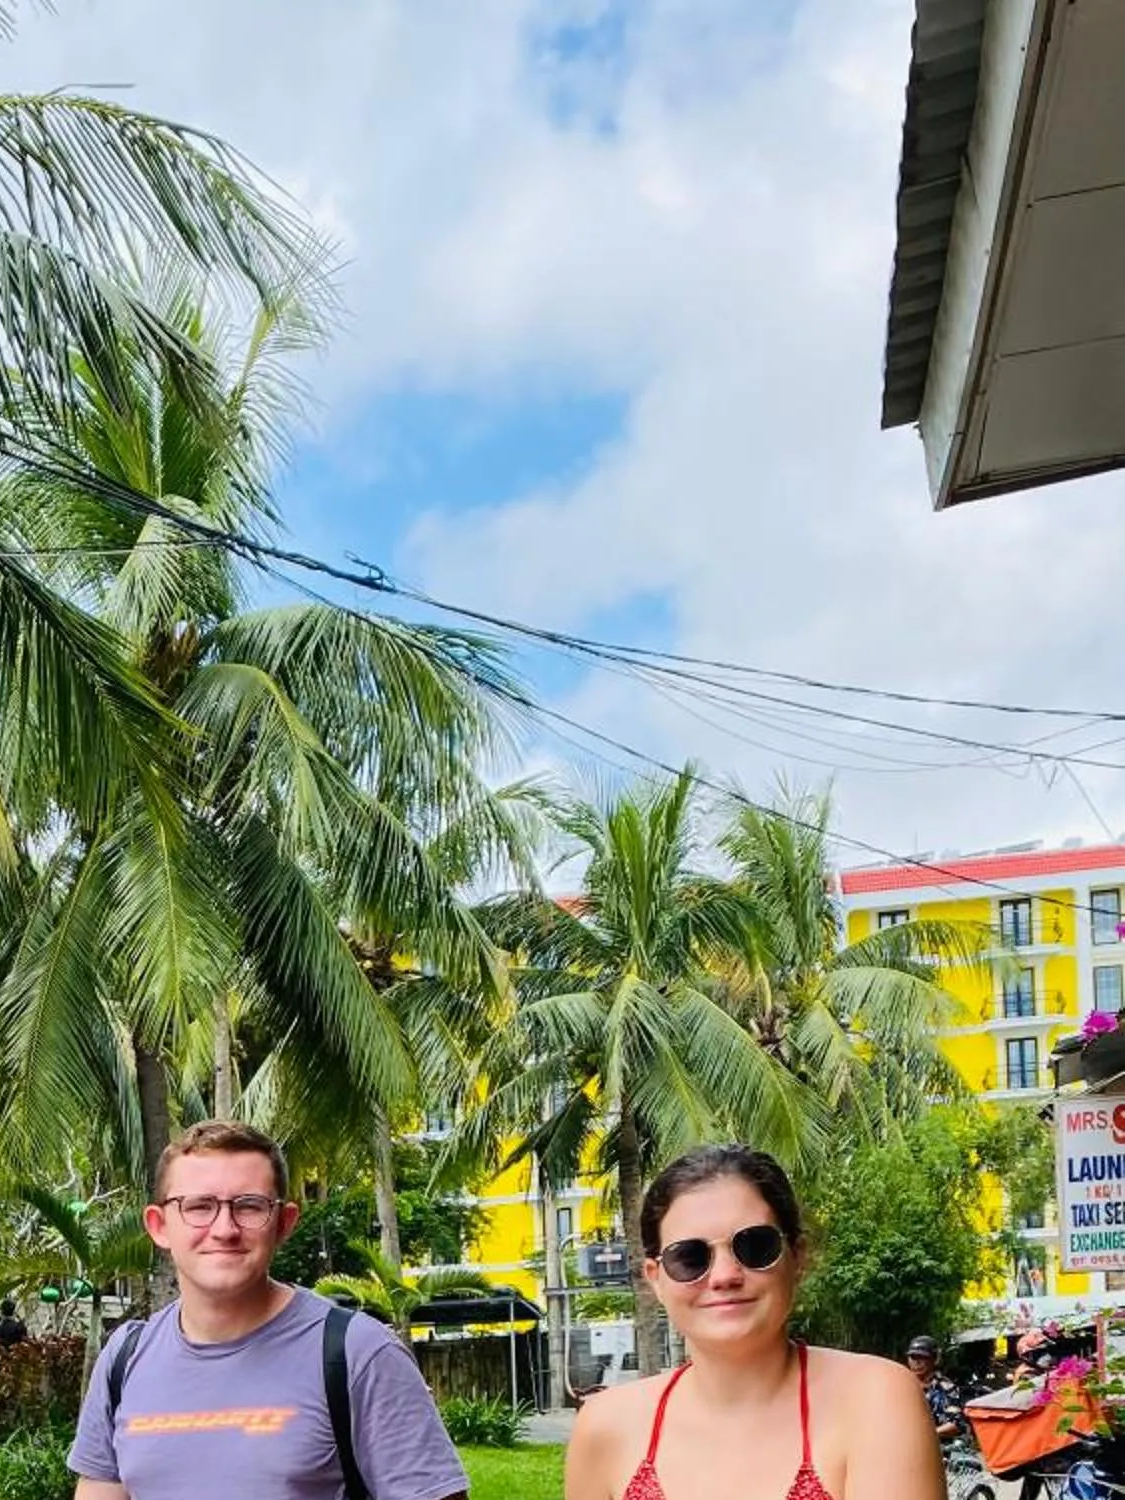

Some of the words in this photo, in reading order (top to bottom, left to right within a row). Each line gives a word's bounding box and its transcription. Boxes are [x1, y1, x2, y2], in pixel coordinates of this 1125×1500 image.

[1068, 1154, 1125, 1182] LAUN
[1071, 1203, 1100, 1228] TAXI
[1070, 1231, 1125, 1252] EXCHANGE
